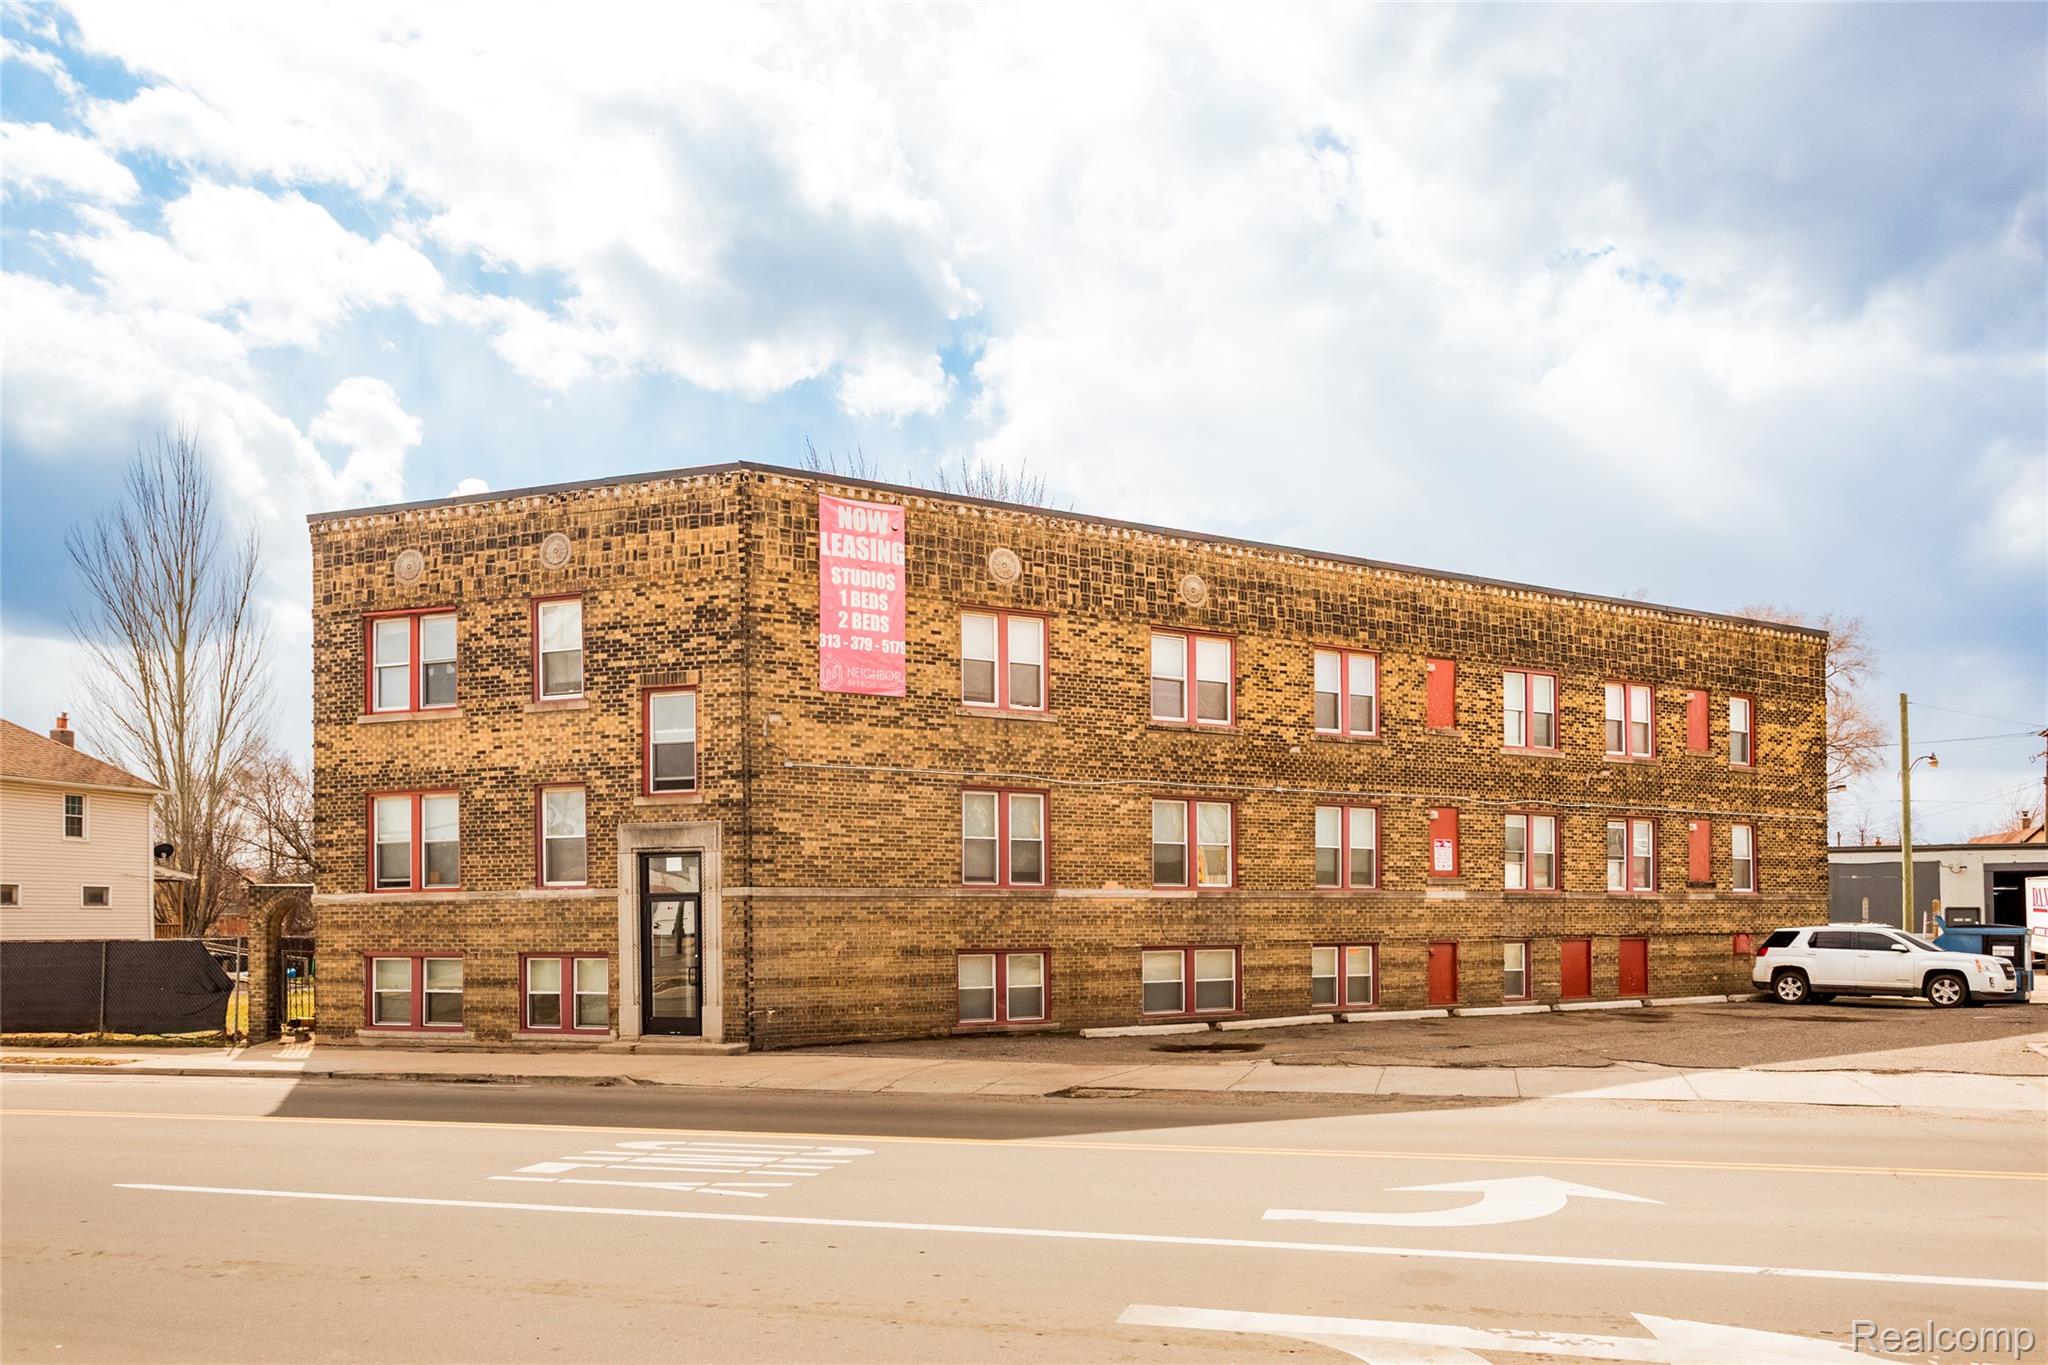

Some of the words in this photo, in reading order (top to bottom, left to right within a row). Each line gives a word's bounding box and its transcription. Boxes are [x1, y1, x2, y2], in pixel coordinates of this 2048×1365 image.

[837, 505, 889, 535] NOW
[820, 532, 905, 566] LEASING
[831, 567, 895, 591] STUDIOS
[840, 589, 847, 607] 1
[851, 591, 888, 612] BEDS
[838, 611, 848, 629] 2
[852, 612, 889, 633] BEDS
[819, 632, 841, 649] 313
[850, 635, 873, 652] 379
